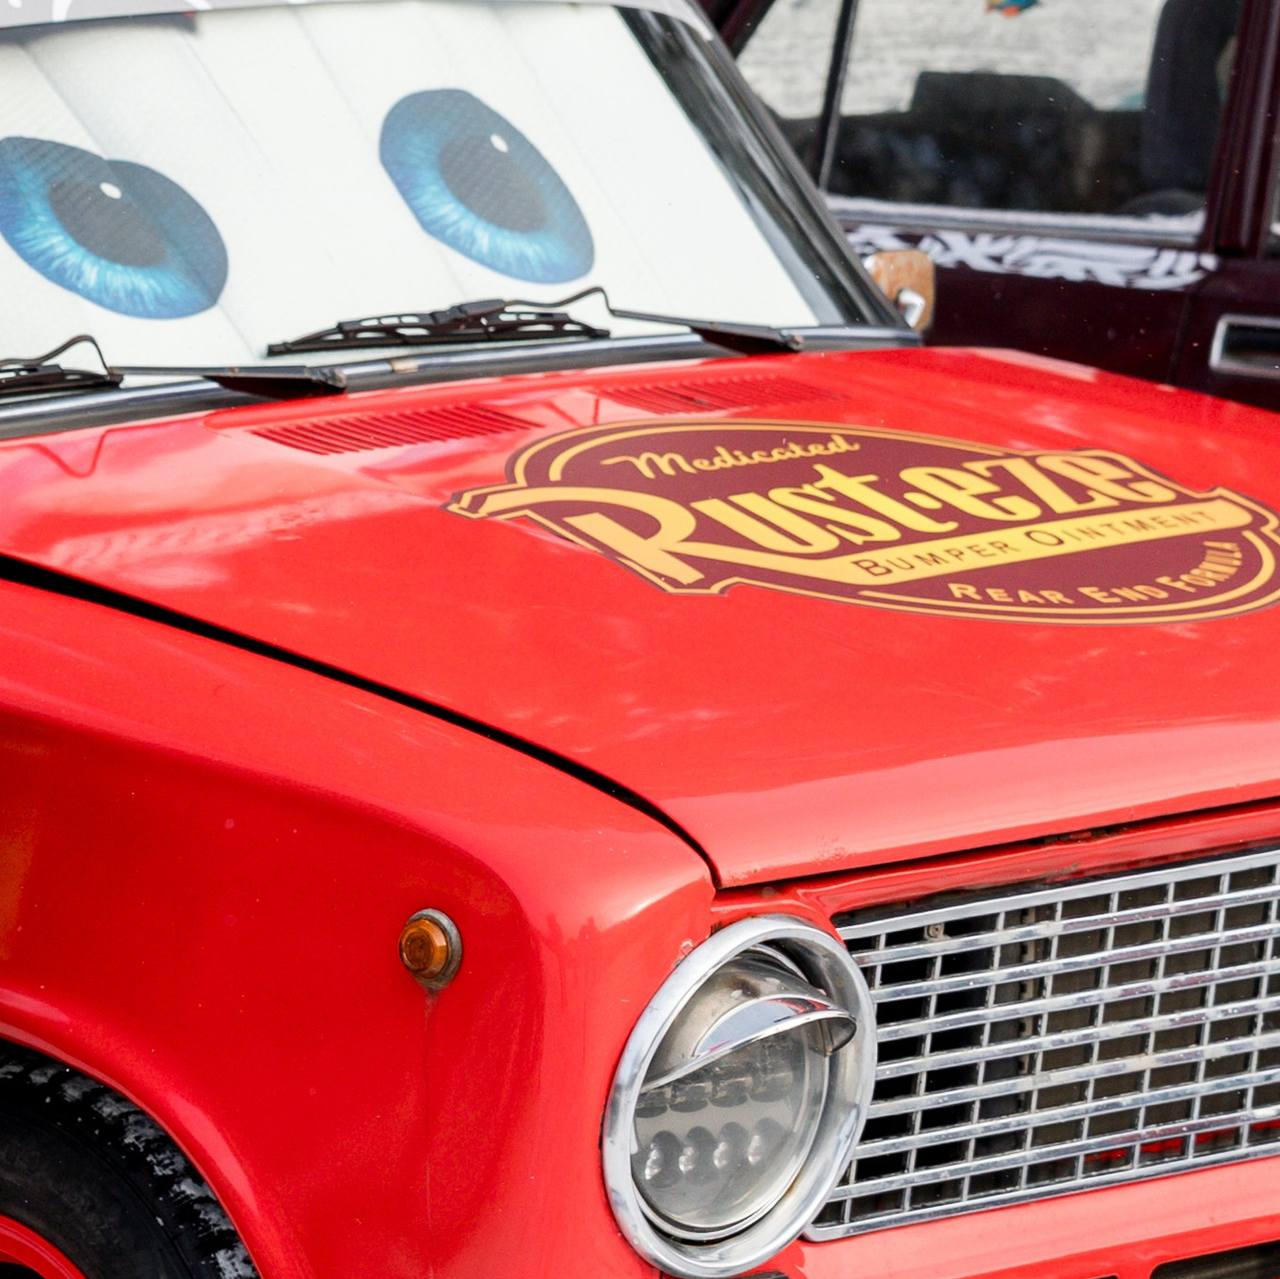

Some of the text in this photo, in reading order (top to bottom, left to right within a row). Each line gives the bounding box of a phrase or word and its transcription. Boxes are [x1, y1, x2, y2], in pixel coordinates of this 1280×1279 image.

[600, 433, 861, 480] Medicated
[851, 510, 1218, 576] BUMPER OINTMENT
[947, 582, 1076, 605] REAR
[1077, 584, 1170, 604] END
